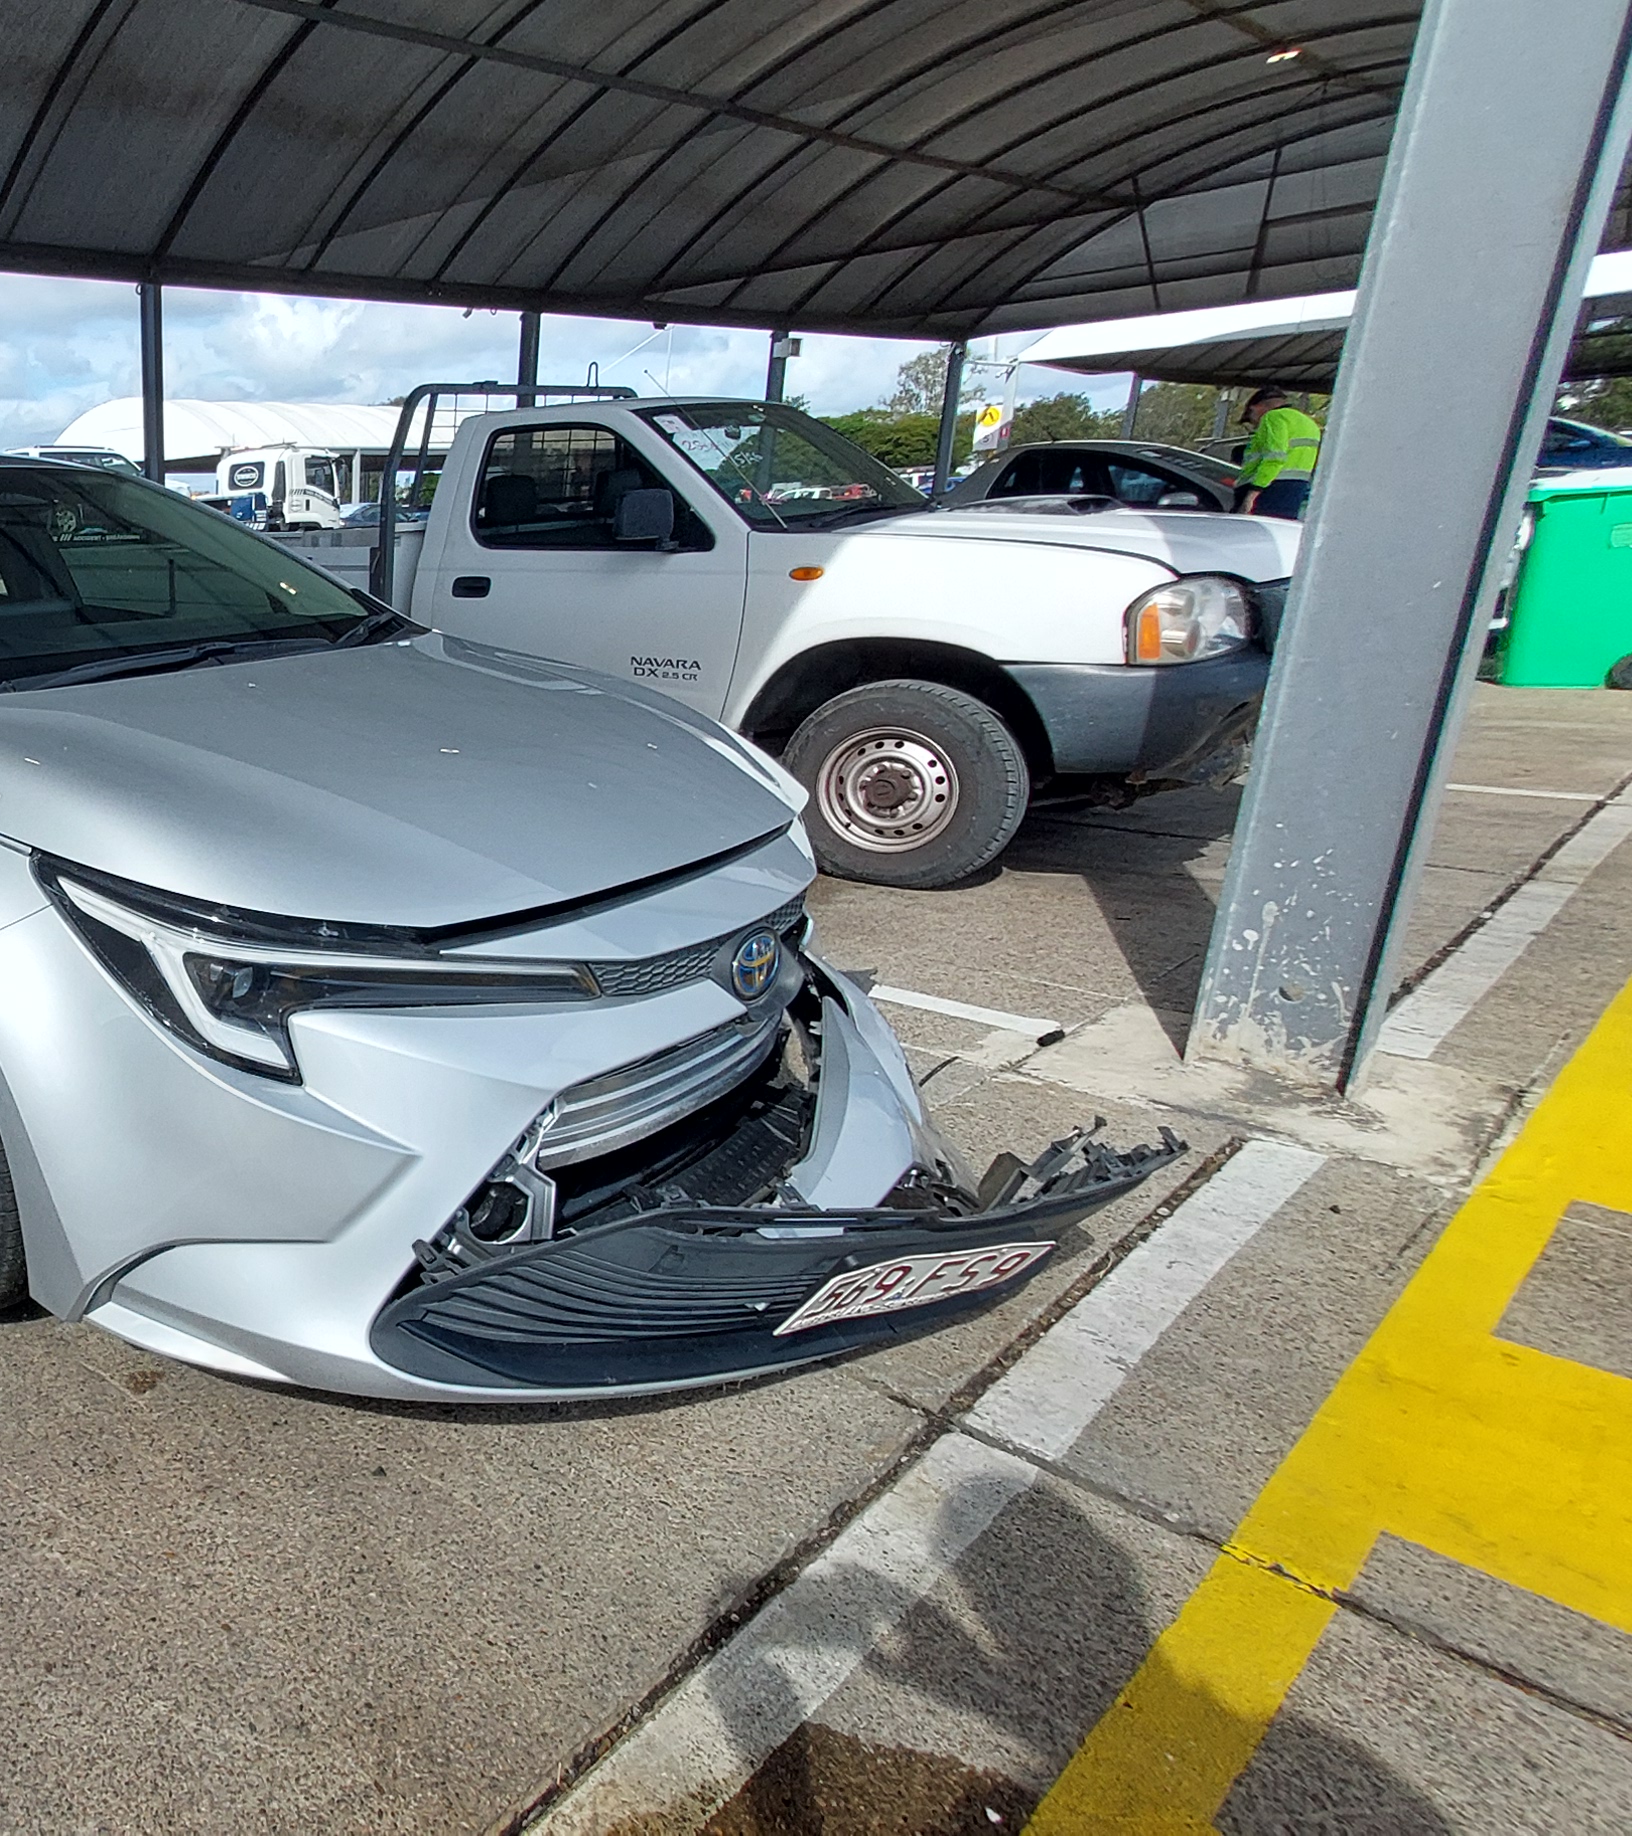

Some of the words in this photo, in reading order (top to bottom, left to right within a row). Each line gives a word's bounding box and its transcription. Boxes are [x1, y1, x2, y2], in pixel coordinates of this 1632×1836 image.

[630, 656, 702, 670] NAVARA
[633, 667, 659, 678] DX
[661, 671, 679, 679] 2.5
[681, 673, 698, 681] CR
